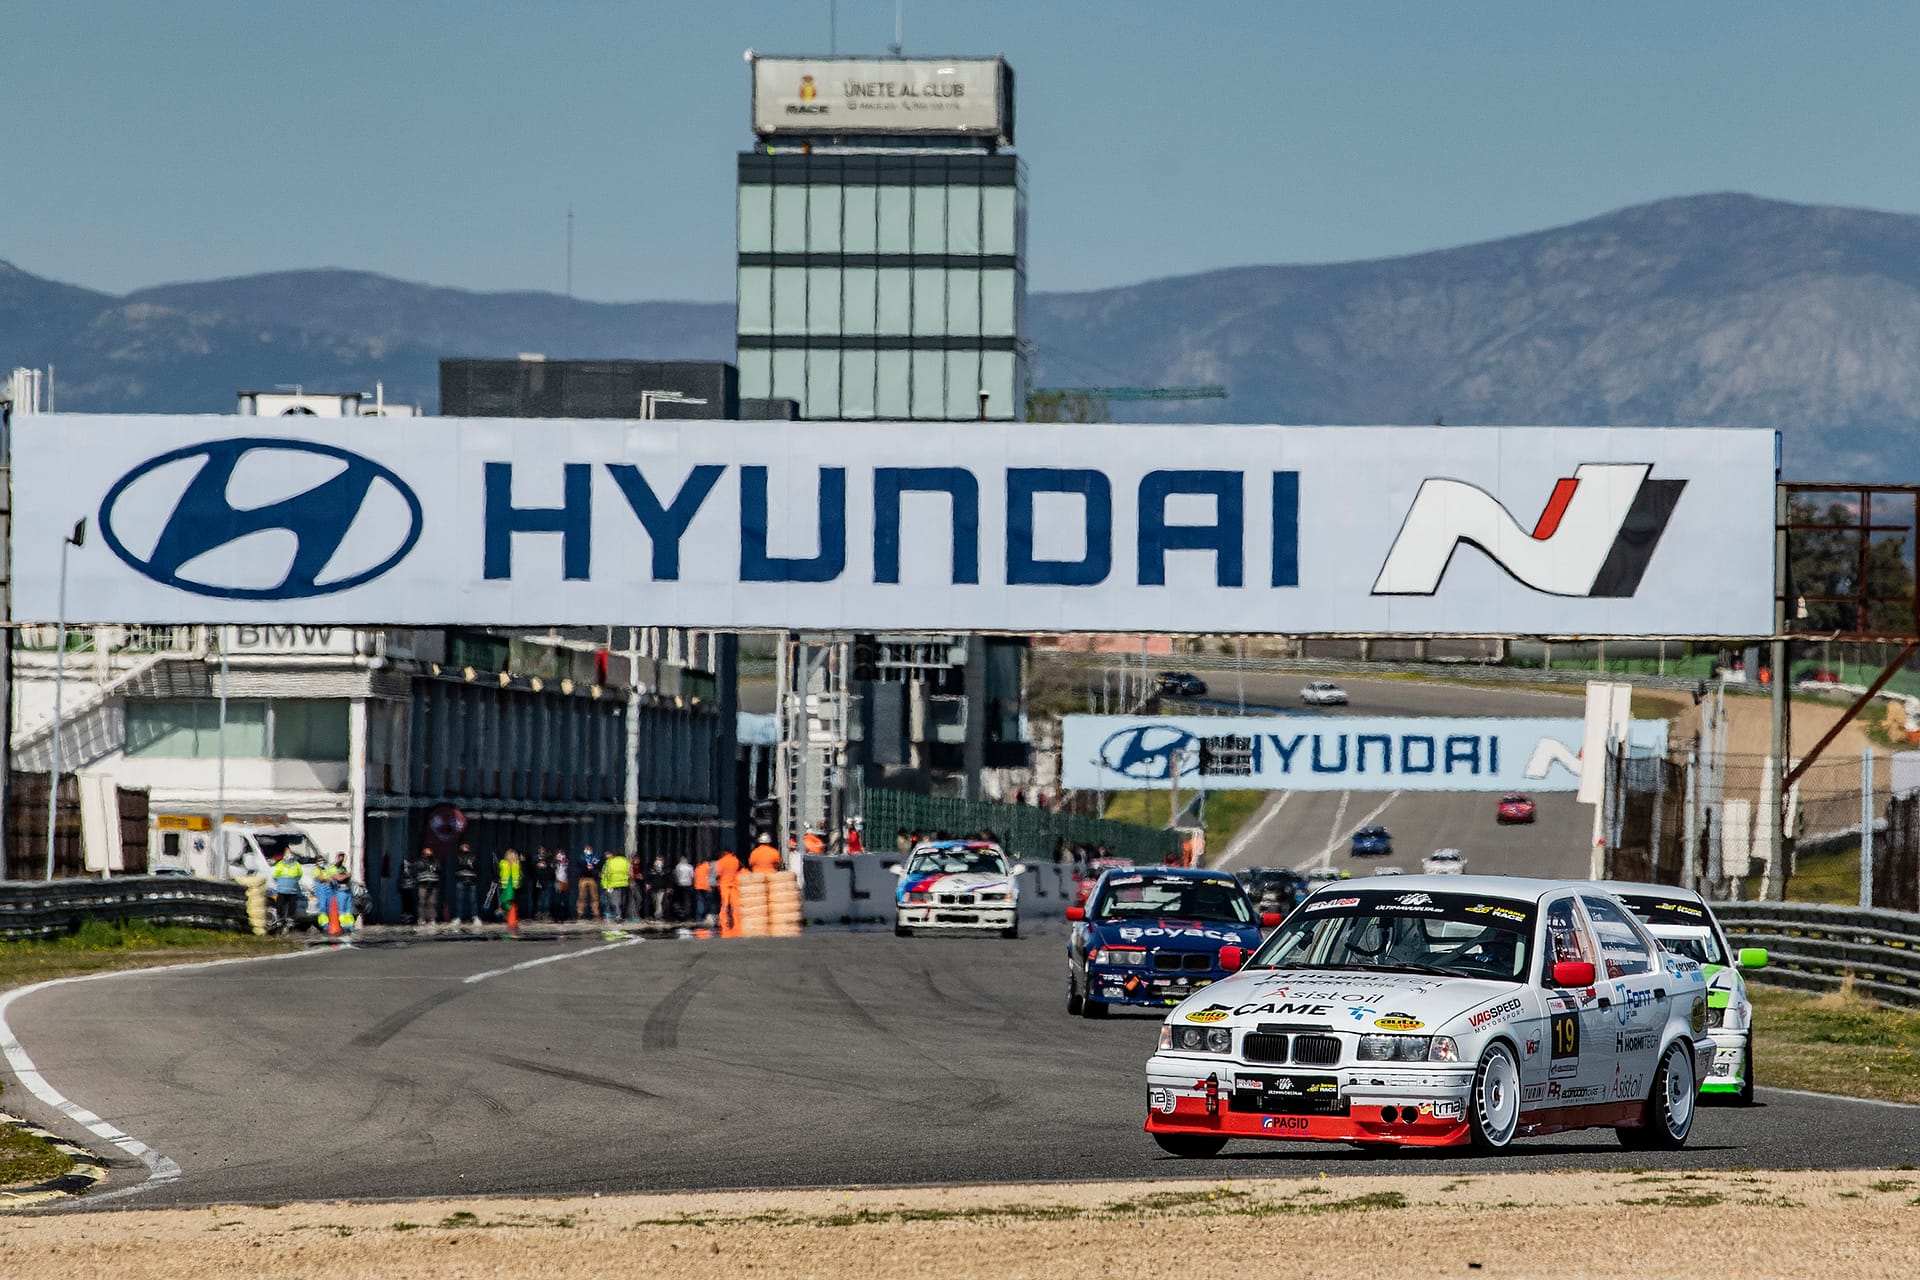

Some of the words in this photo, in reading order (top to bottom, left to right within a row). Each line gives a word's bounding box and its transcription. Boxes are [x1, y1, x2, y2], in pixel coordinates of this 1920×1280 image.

[483, 461, 1301, 588] HYUNDAI
[239, 625, 333, 648] BMW
[1252, 734, 1498, 775] YUNDAI
[1492, 911, 1523, 922] RACE
[1233, 1003, 1334, 1016] CAME
[1468, 997, 1522, 1027] VAGSPEED
[1474, 1008, 1526, 1034] MOTORSPORT
[1555, 1018, 1575, 1053] 19
[1273, 1116, 1309, 1129] PAGID
